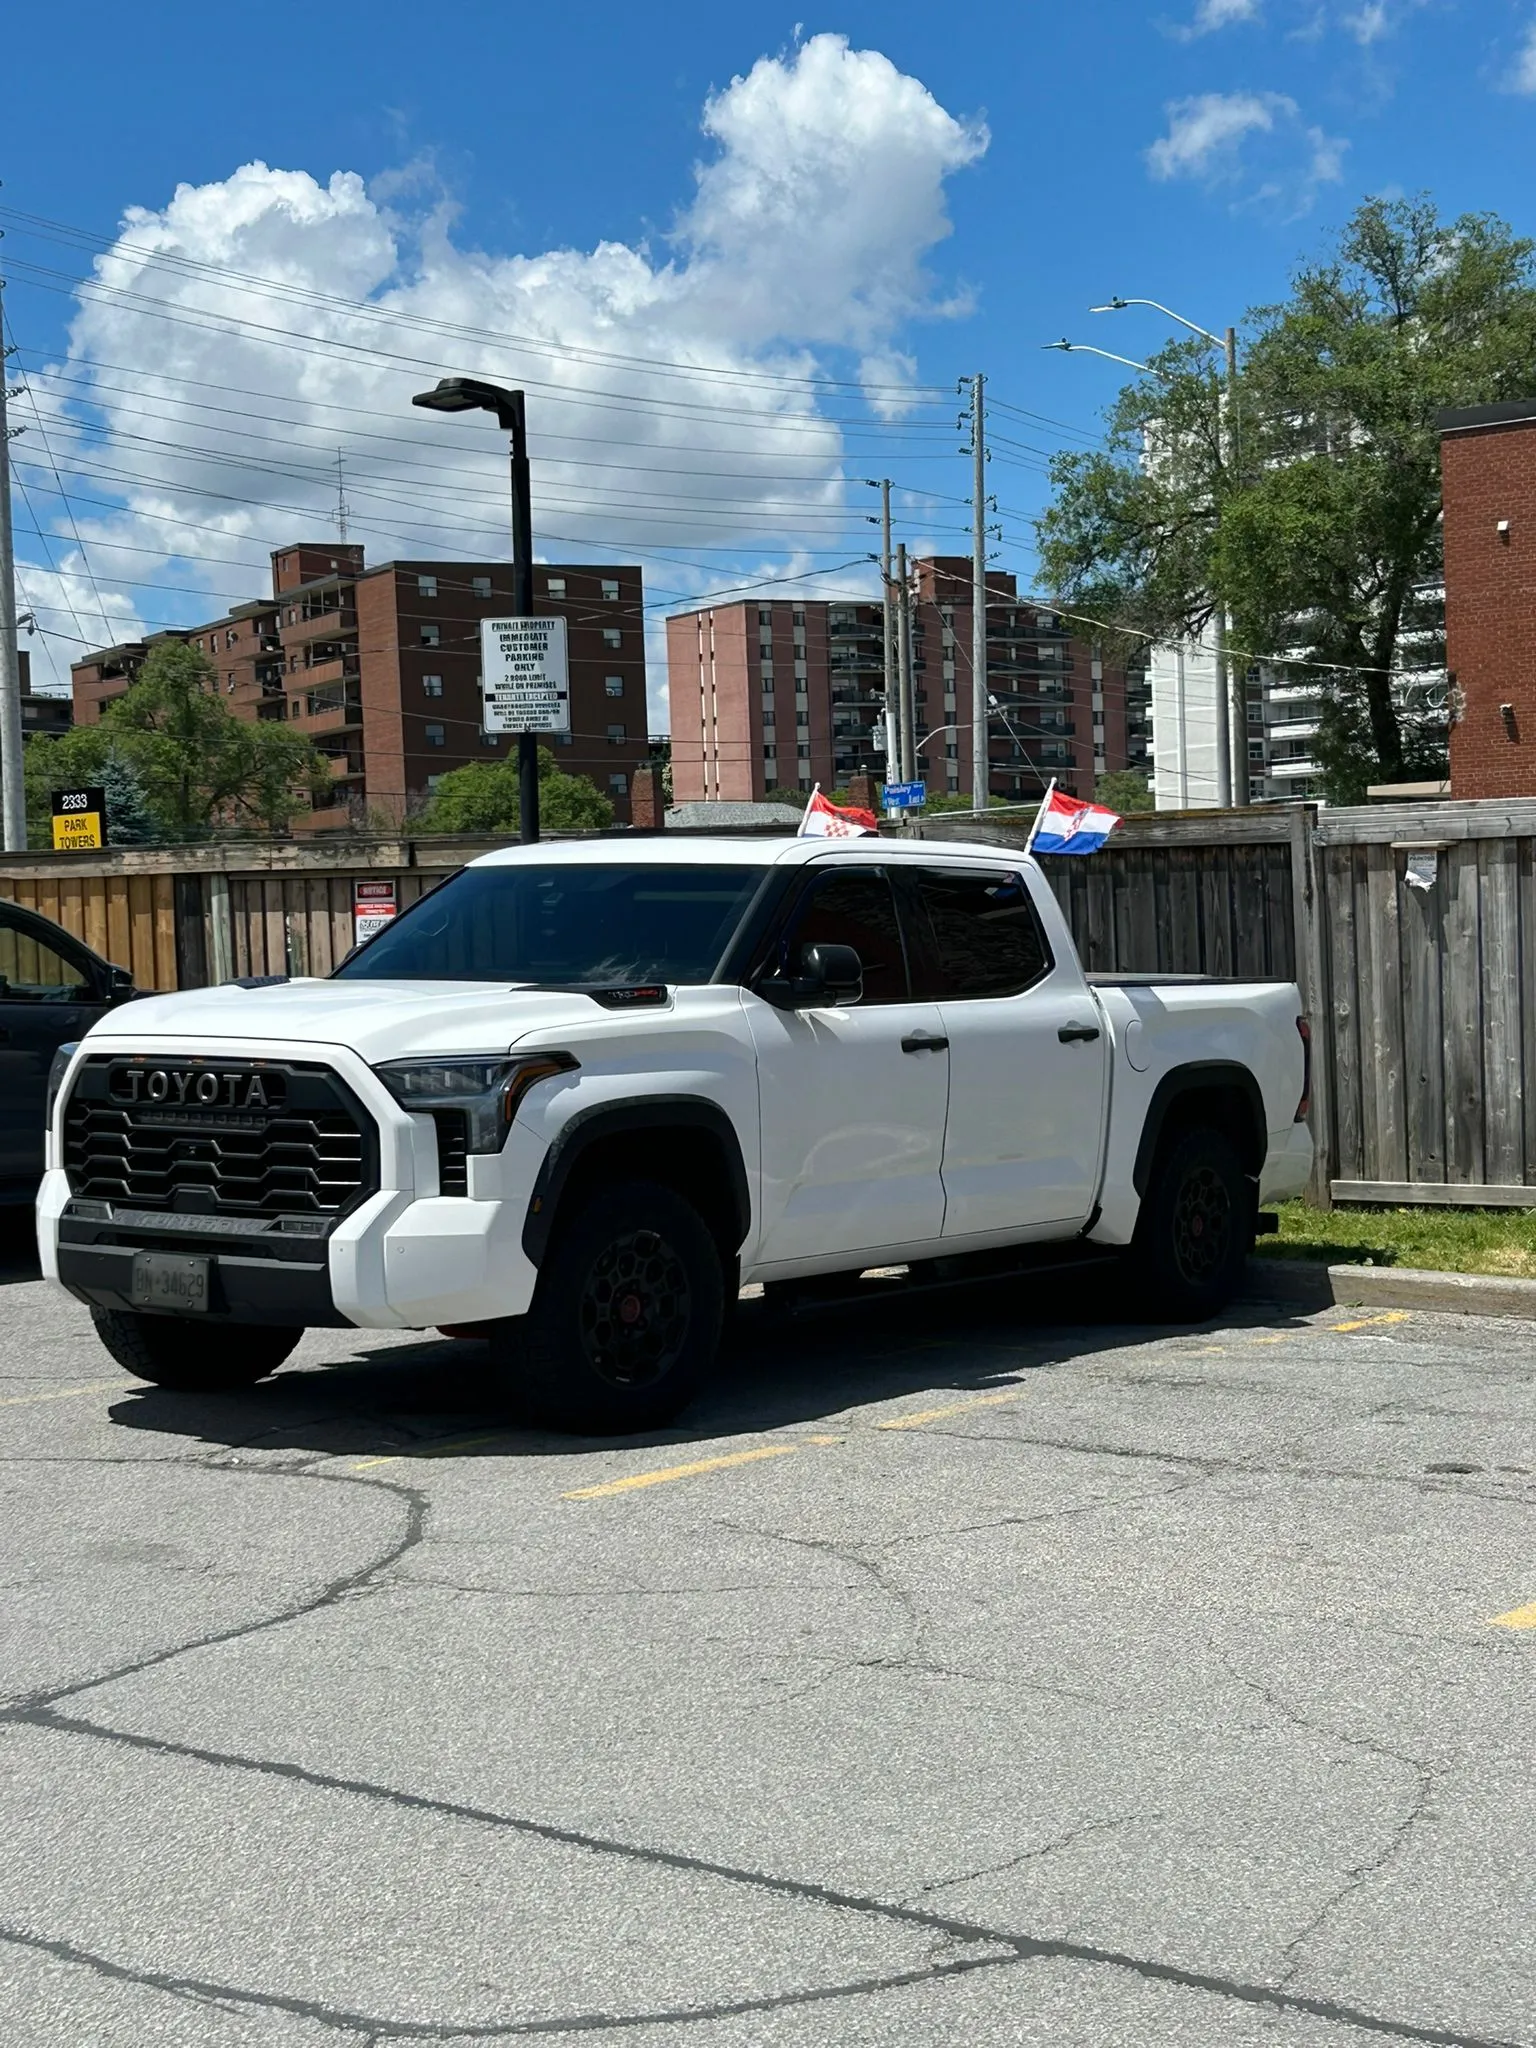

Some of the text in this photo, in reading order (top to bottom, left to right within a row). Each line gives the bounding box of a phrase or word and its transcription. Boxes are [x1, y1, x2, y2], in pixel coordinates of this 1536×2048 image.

[500, 632, 548, 642] IMMEDIATE
[500, 643, 549, 652] CUSTOMER
[505, 653, 545, 662] PARKING
[514, 663, 535, 671] ONLY
[885, 784, 911, 795] Paisley
[62, 793, 88, 809] 2333
[64, 819, 87, 831] PARK
[59, 834, 95, 849] TOWERS
[127, 1070, 268, 1107] TOYOTA
[161, 1270, 204, 1298] 34629
